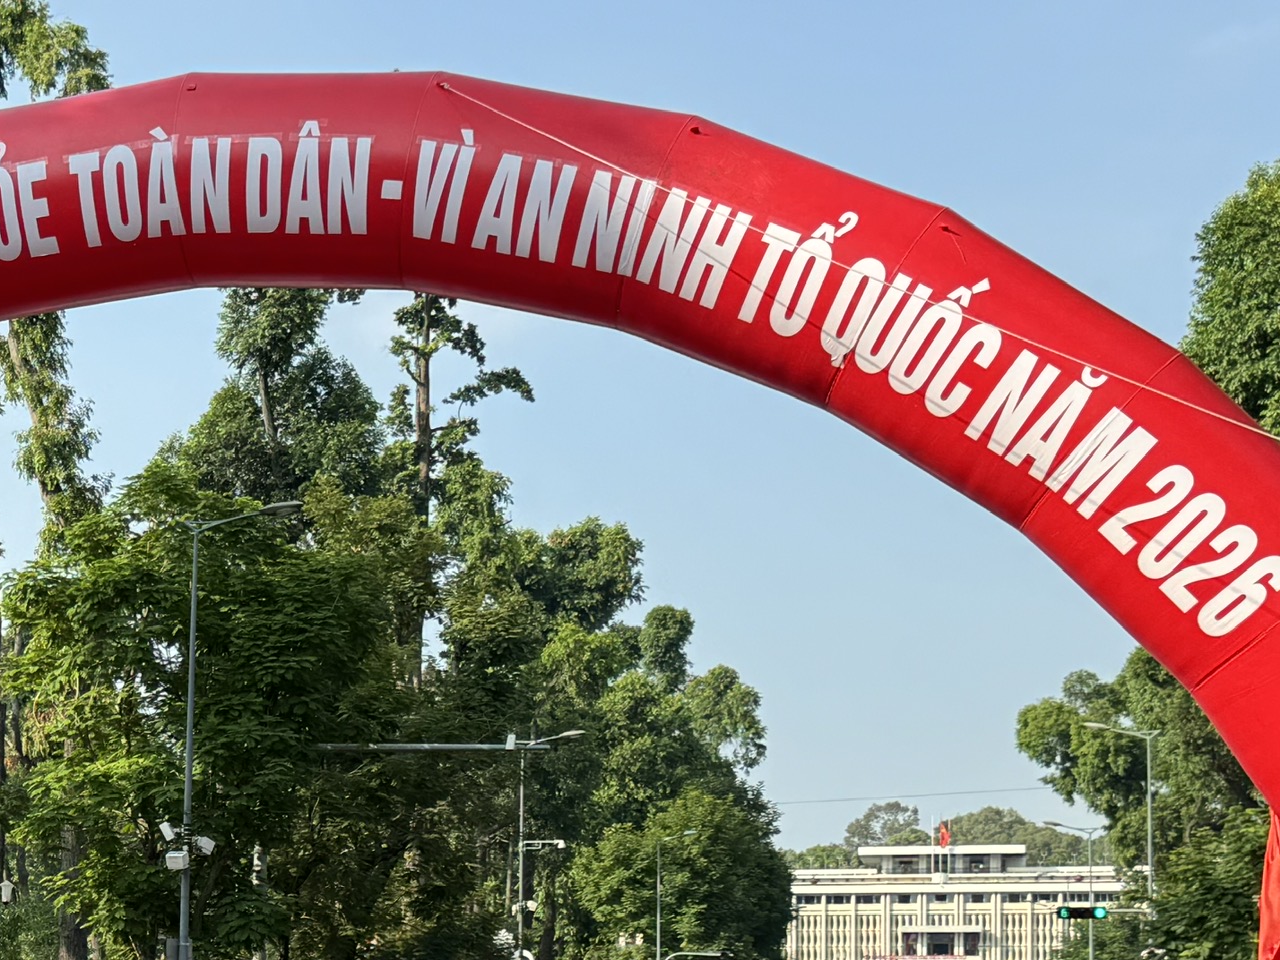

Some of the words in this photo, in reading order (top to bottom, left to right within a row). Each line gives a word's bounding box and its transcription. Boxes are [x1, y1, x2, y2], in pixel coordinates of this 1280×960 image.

[69, 127, 231, 248] TOÀN
[413, 129, 475, 244] VÌ
[472, 153, 577, 263] AN
[572, 170, 753, 309] NINH
[737, 211, 859, 336] TỔ
[820, 257, 1002, 418] QUỐC
[964, 349, 1158, 520] NĂM
[1097, 464, 1280, 638] 2026
